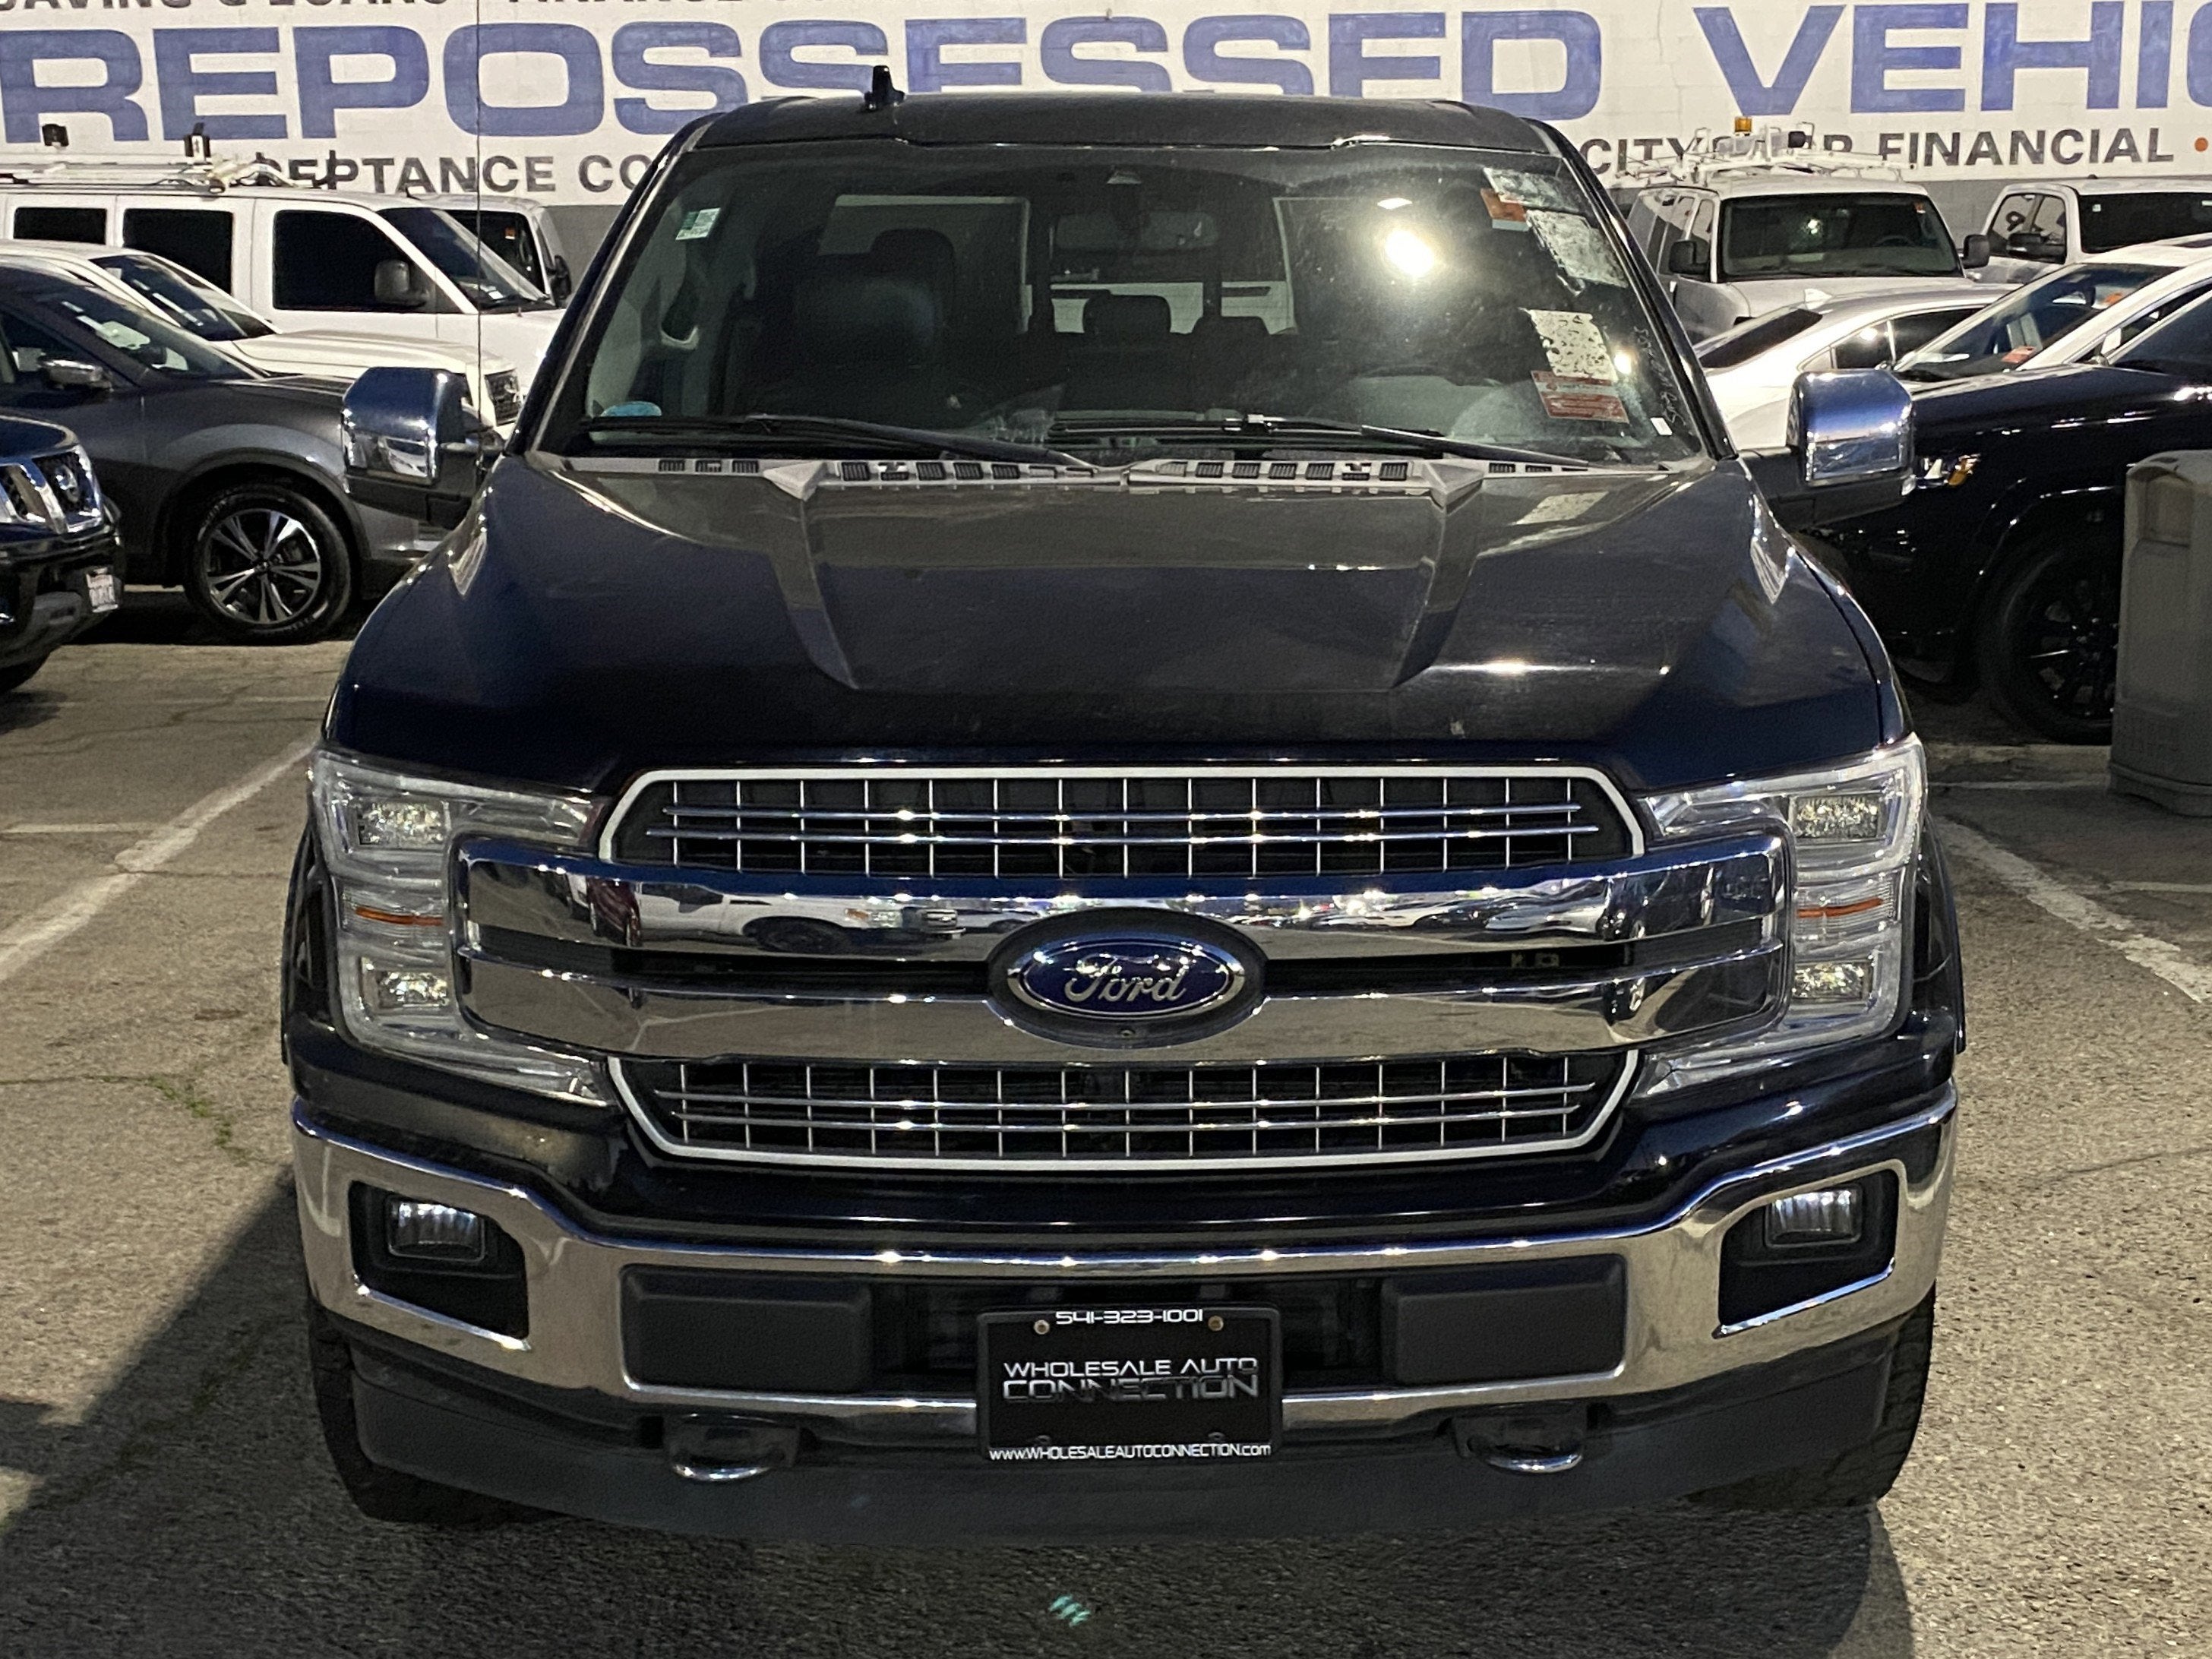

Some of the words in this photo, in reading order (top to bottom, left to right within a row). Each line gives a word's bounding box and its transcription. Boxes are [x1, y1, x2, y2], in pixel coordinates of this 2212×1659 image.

[0, 10, 1601, 144] REPOSSESSED
[1692, 1, 2212, 115] VEHI
[262, 154, 557, 193] EPTANCE
[1879, 127, 2175, 167] FINANCIAL
[1063, 953, 1188, 1003] Ford
[1055, 1308, 1204, 1326] 541-323-1001
[1003, 1360, 1172, 1377] WHOLESALE
[1180, 1357, 1258, 1374] AUTO
[1003, 1375, 1259, 1403] CONNECTION
[989, 1443, 1272, 1460] www.WHOLESALEAUTOCONNECTION.com
